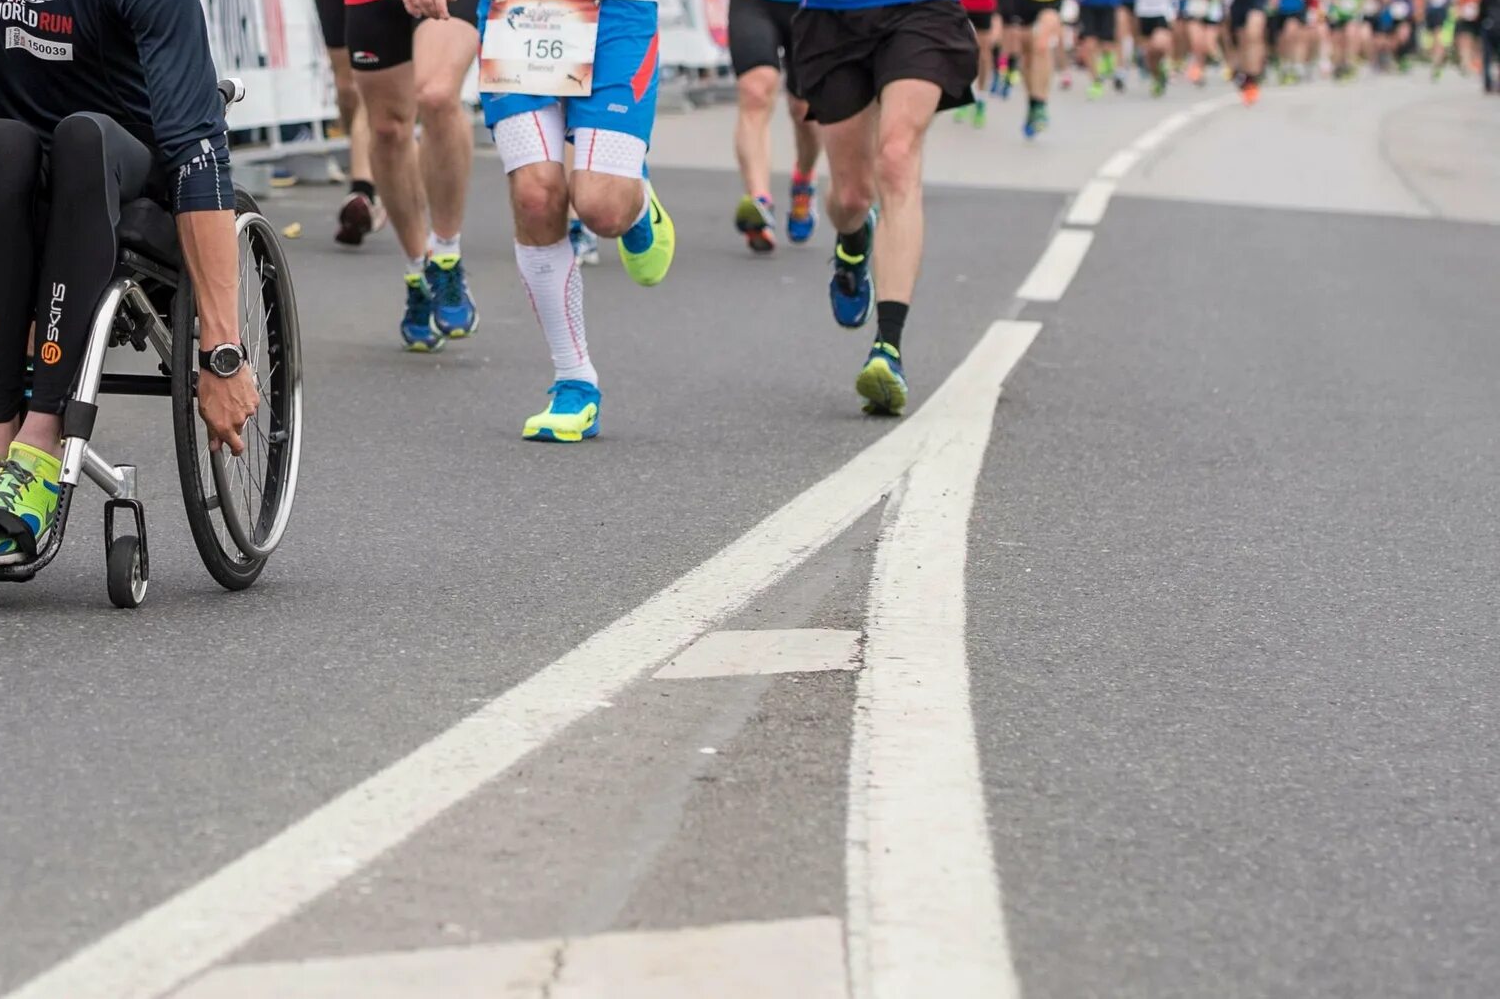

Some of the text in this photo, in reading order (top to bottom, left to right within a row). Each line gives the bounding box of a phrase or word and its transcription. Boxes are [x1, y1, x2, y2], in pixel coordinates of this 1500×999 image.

[39, 12, 73, 35] RUN
[27, 39, 67, 56] 150039
[523, 39, 563, 59] 156
[46, 282, 66, 342] SKINS
